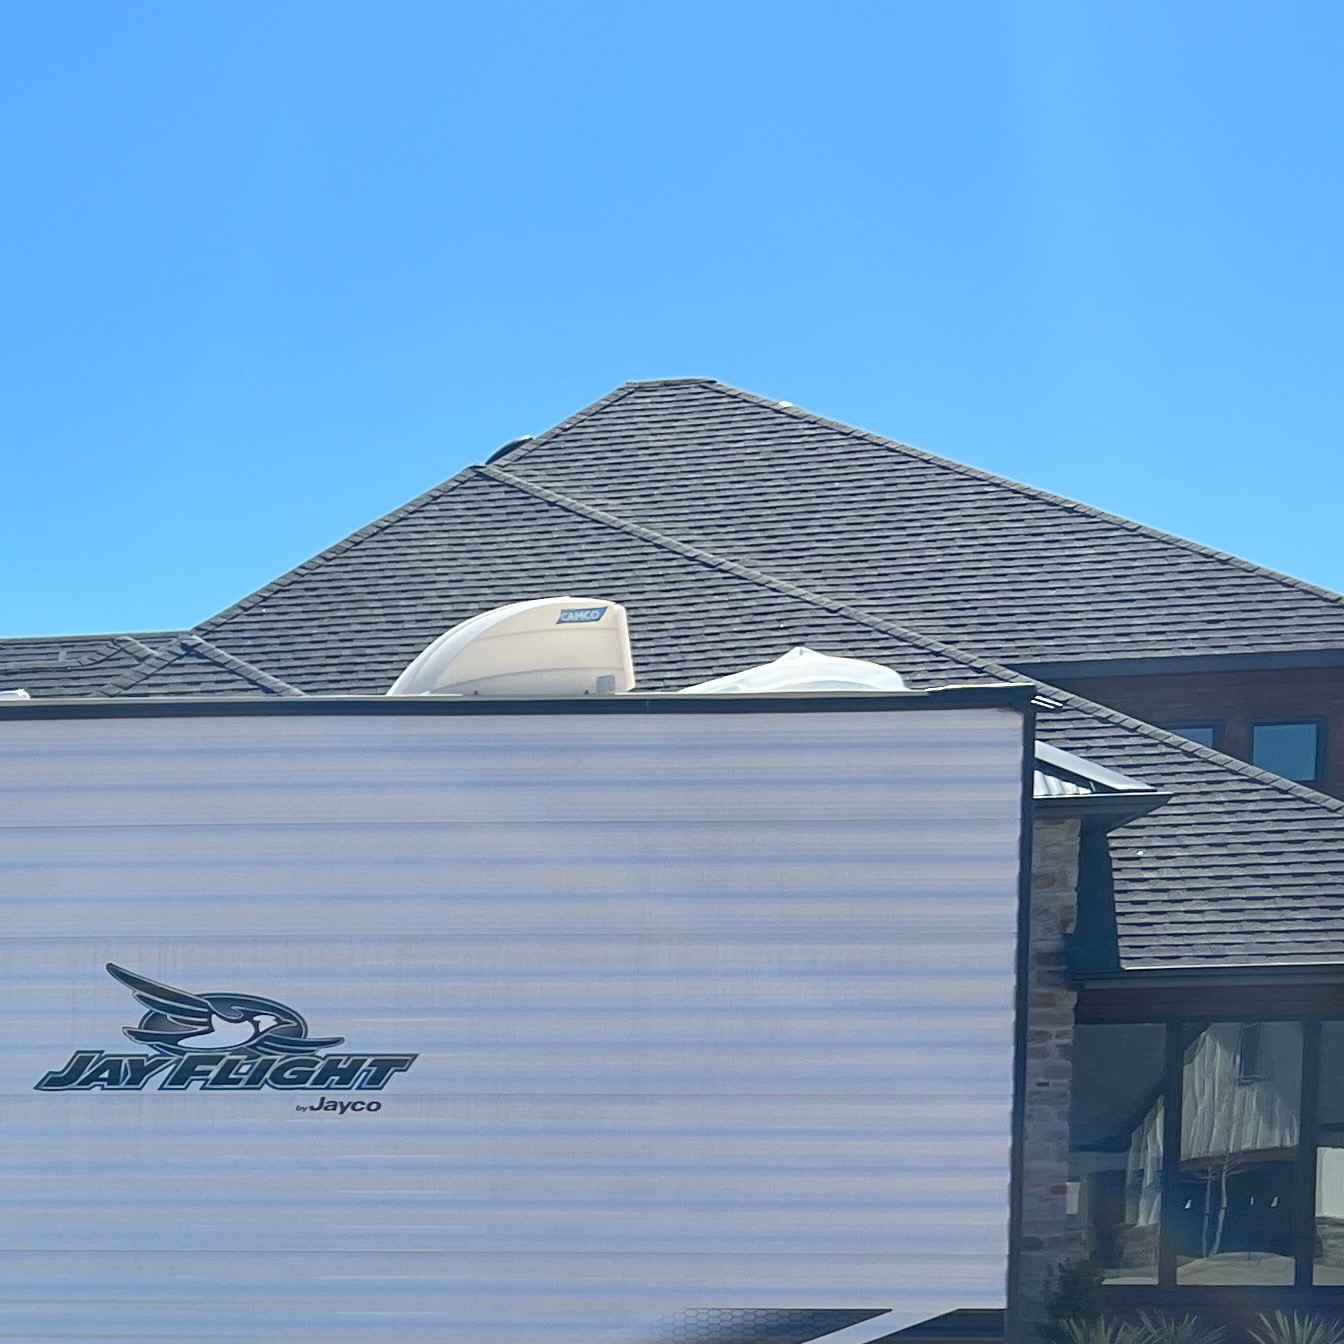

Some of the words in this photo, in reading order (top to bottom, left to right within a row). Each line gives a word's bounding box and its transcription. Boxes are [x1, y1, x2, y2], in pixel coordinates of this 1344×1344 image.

[561, 609, 600, 622] CAMCO
[32, 1049, 176, 1092] JAY
[158, 1053, 420, 1092] FLIGHT
[309, 1097, 382, 1115] Jayco
